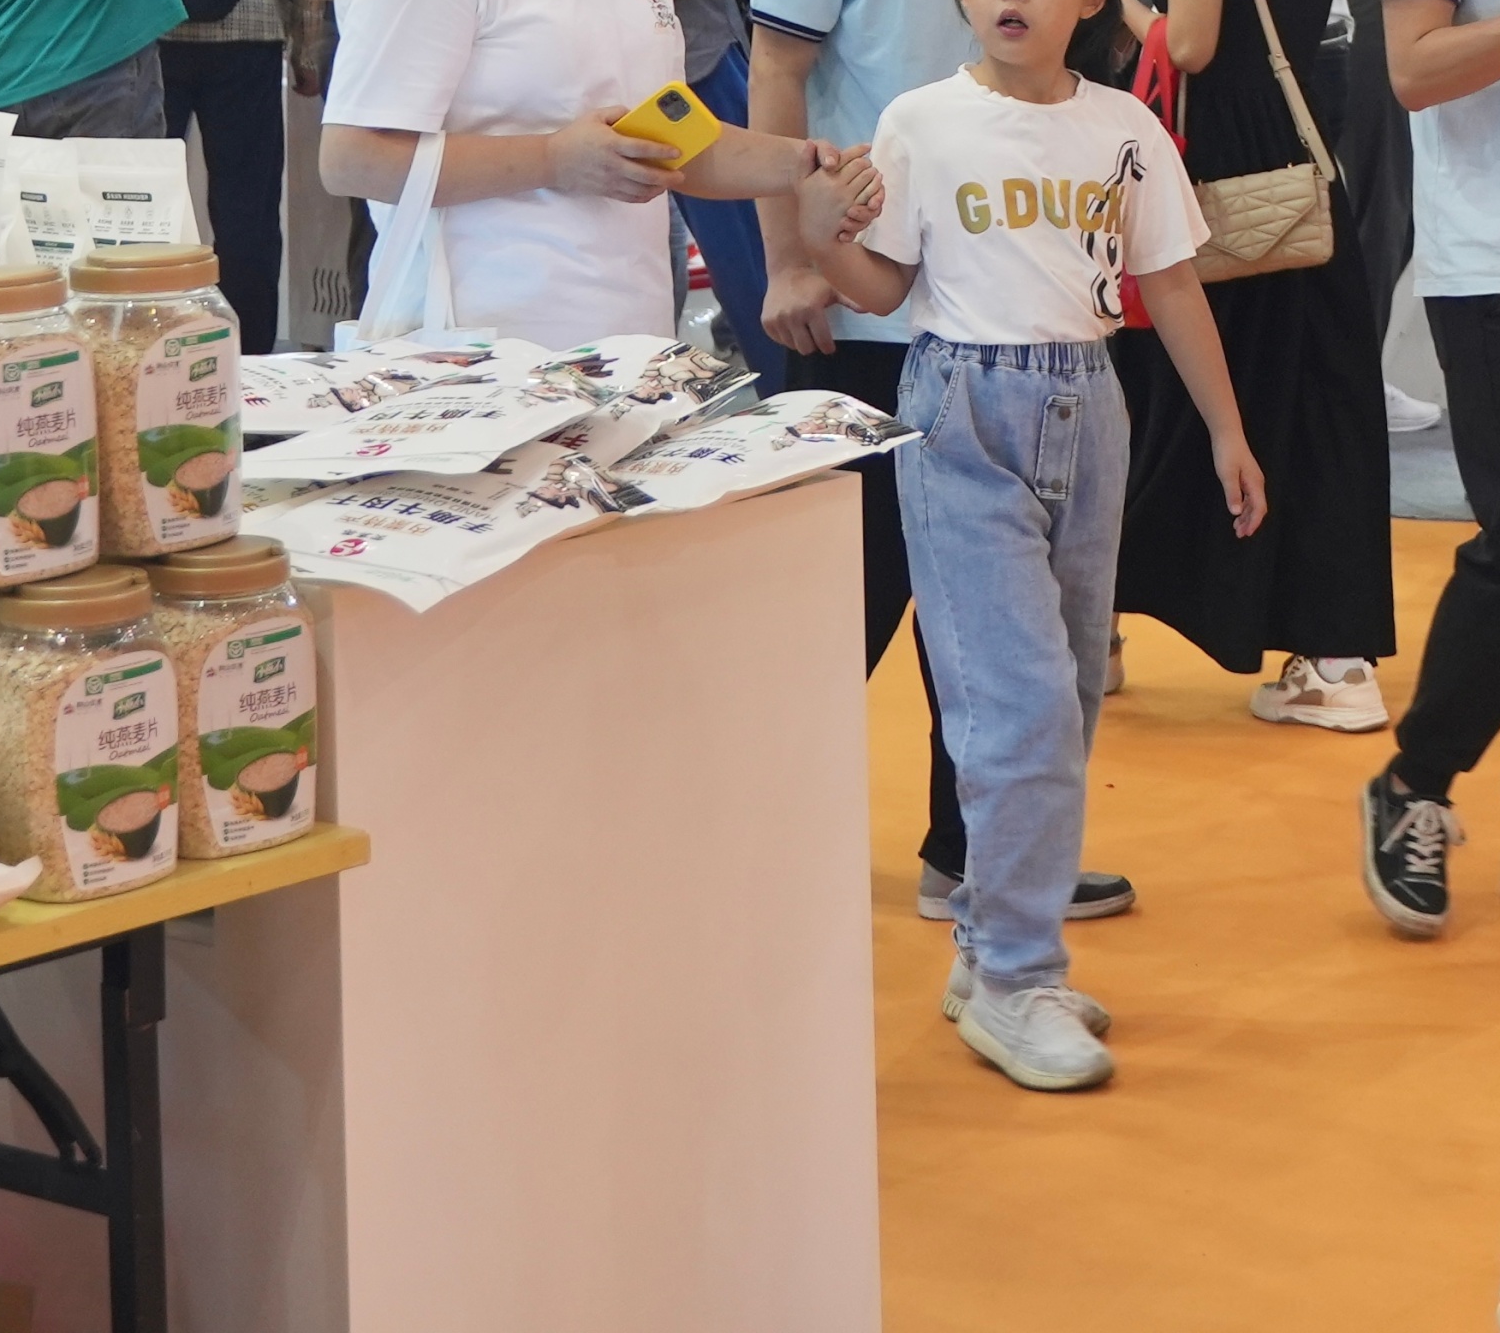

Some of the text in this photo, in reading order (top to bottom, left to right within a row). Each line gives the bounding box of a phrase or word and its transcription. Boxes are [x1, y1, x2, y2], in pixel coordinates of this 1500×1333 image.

[955, 176, 1125, 236] G.DUCK
[176, 383, 228, 411] 纯燕麦片
[16, 409, 77, 437] 纯燕麦片
[238, 682, 297, 714] 纯燕麦片
[98, 717, 159, 751] 纯燕麦片
